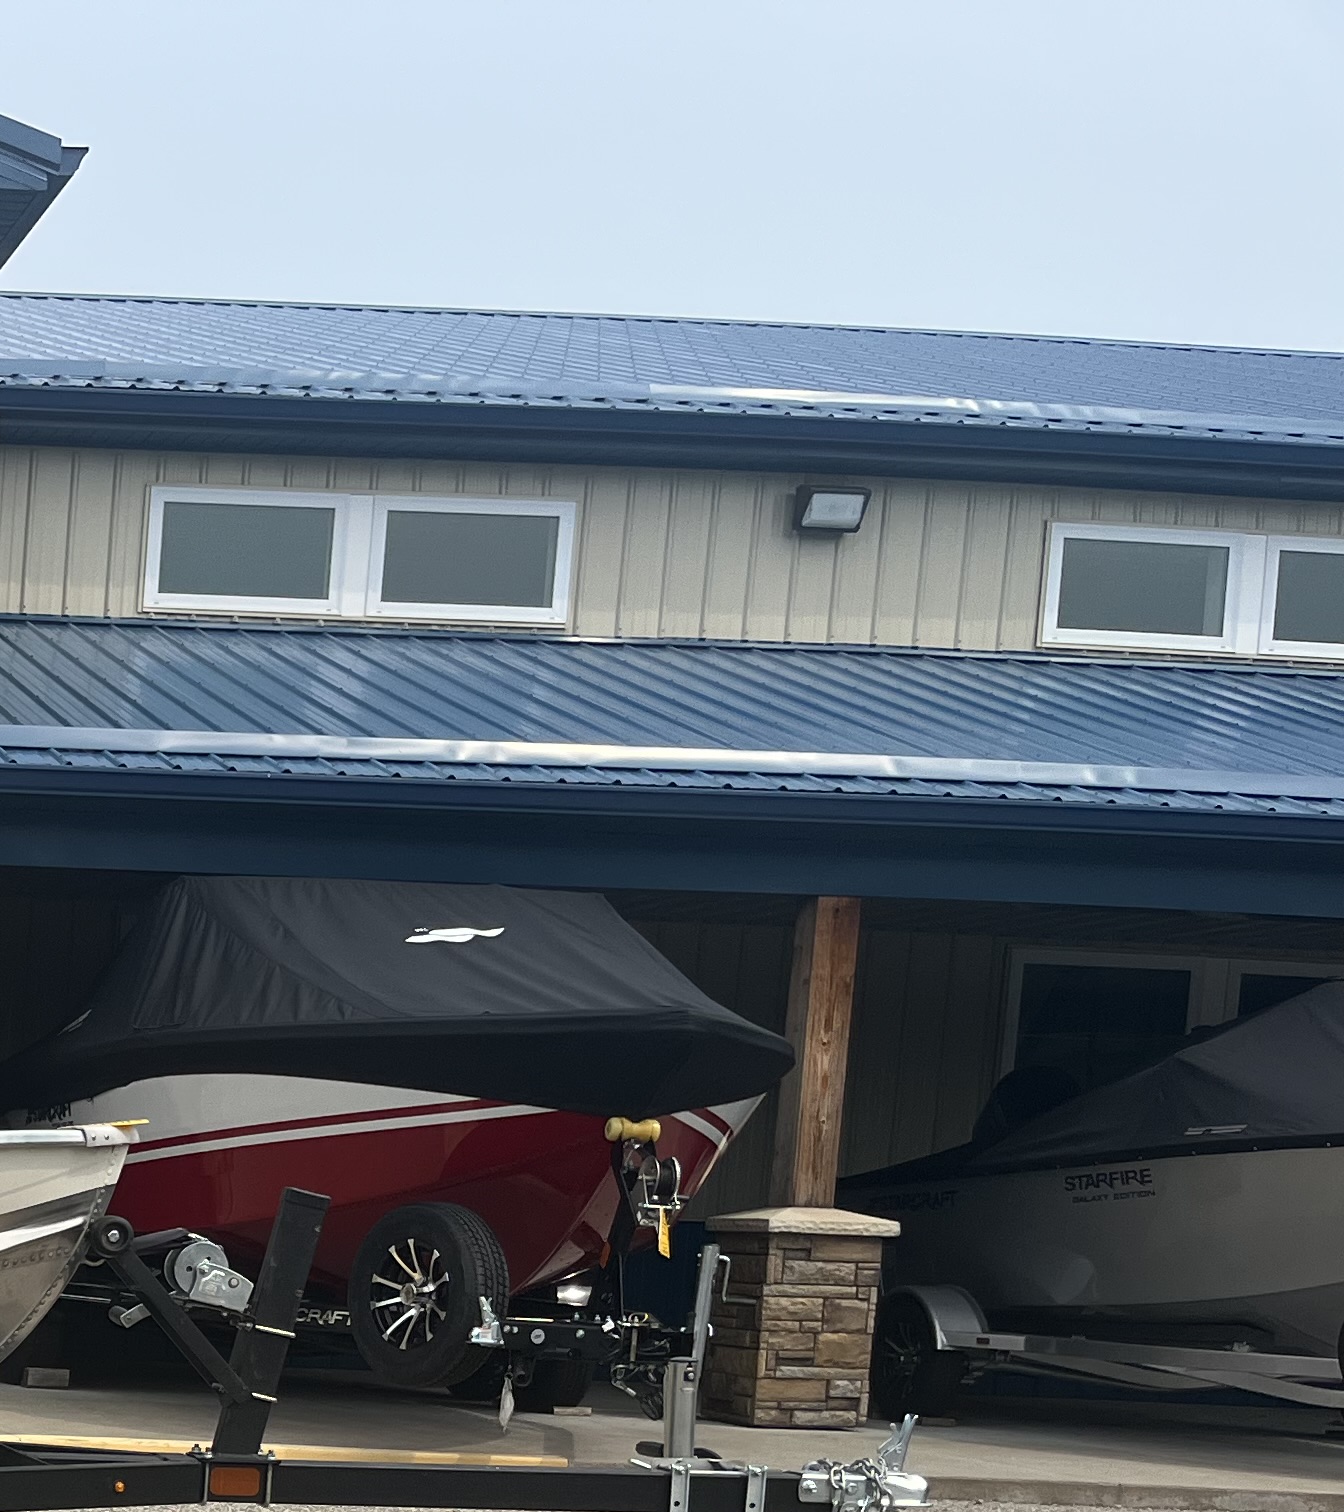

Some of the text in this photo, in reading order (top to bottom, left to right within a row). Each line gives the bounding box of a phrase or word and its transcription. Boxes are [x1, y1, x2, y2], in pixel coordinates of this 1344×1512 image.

[1064, 1168, 1153, 1191] STARFIRE
[1072, 1189, 1156, 1203] GALAXY EDITION
